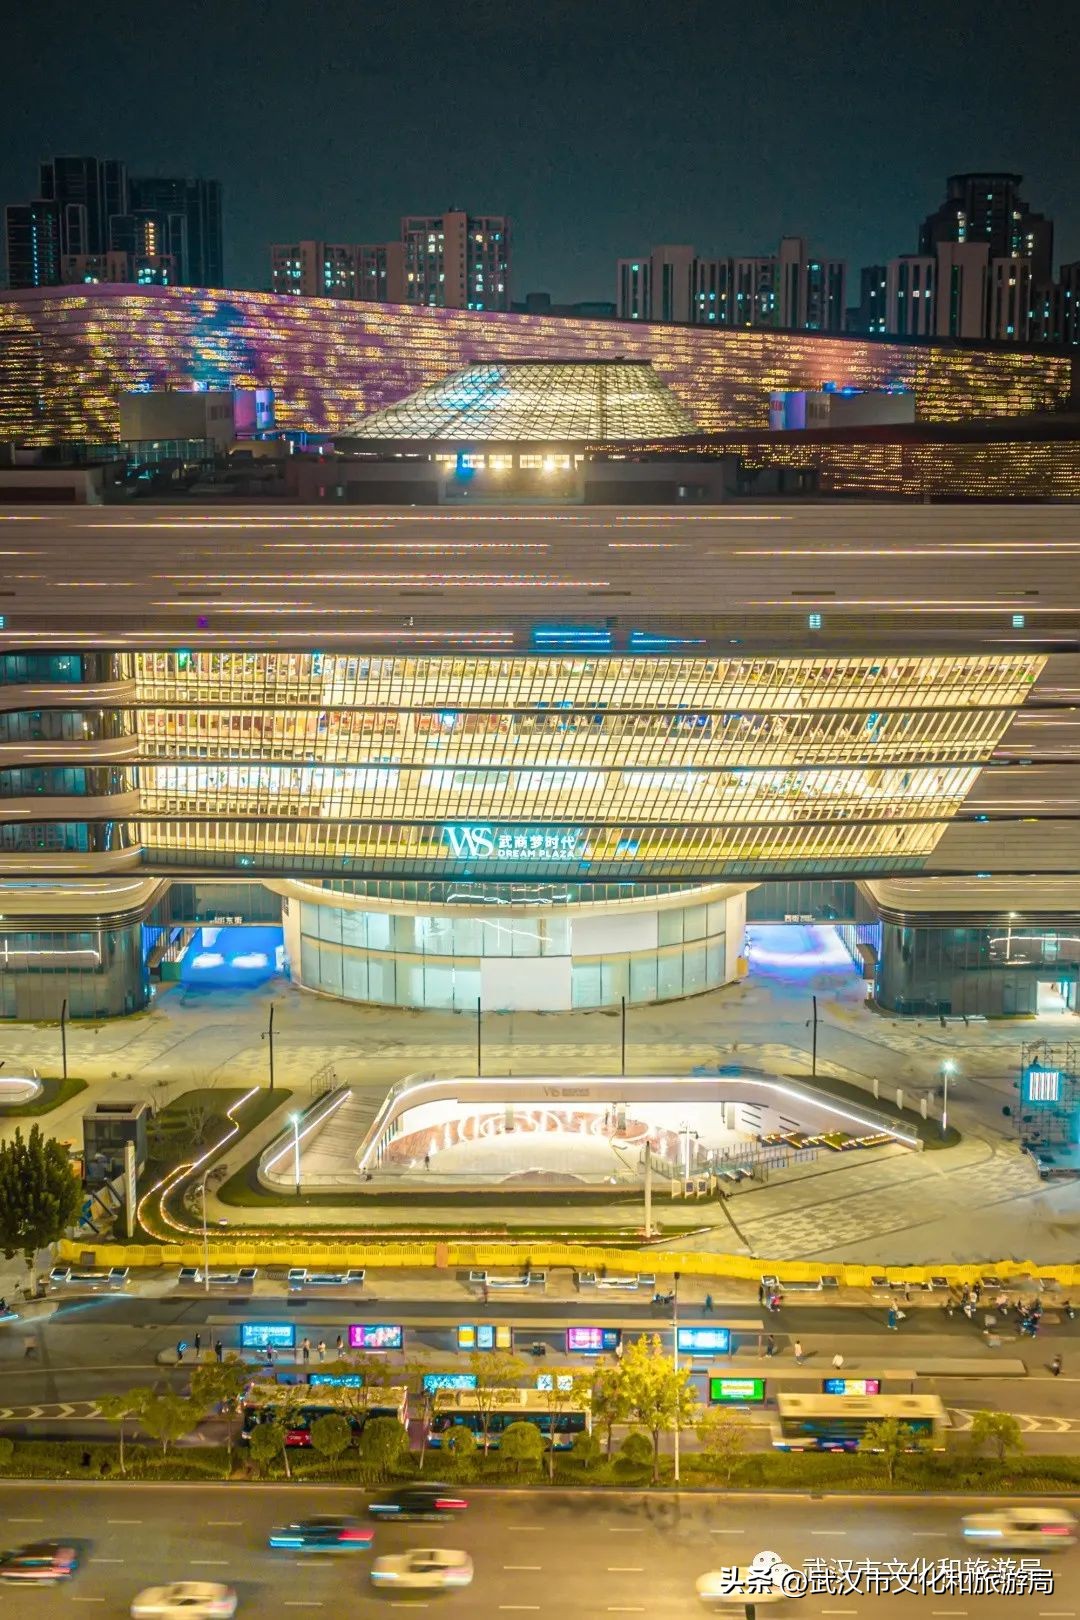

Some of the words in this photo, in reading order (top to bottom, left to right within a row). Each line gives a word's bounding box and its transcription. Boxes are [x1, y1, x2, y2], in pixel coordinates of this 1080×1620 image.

[498, 834, 575, 849] 武商梦时代
[498, 849, 536, 858] DREAM
[539, 849, 574, 858] PLAZA
